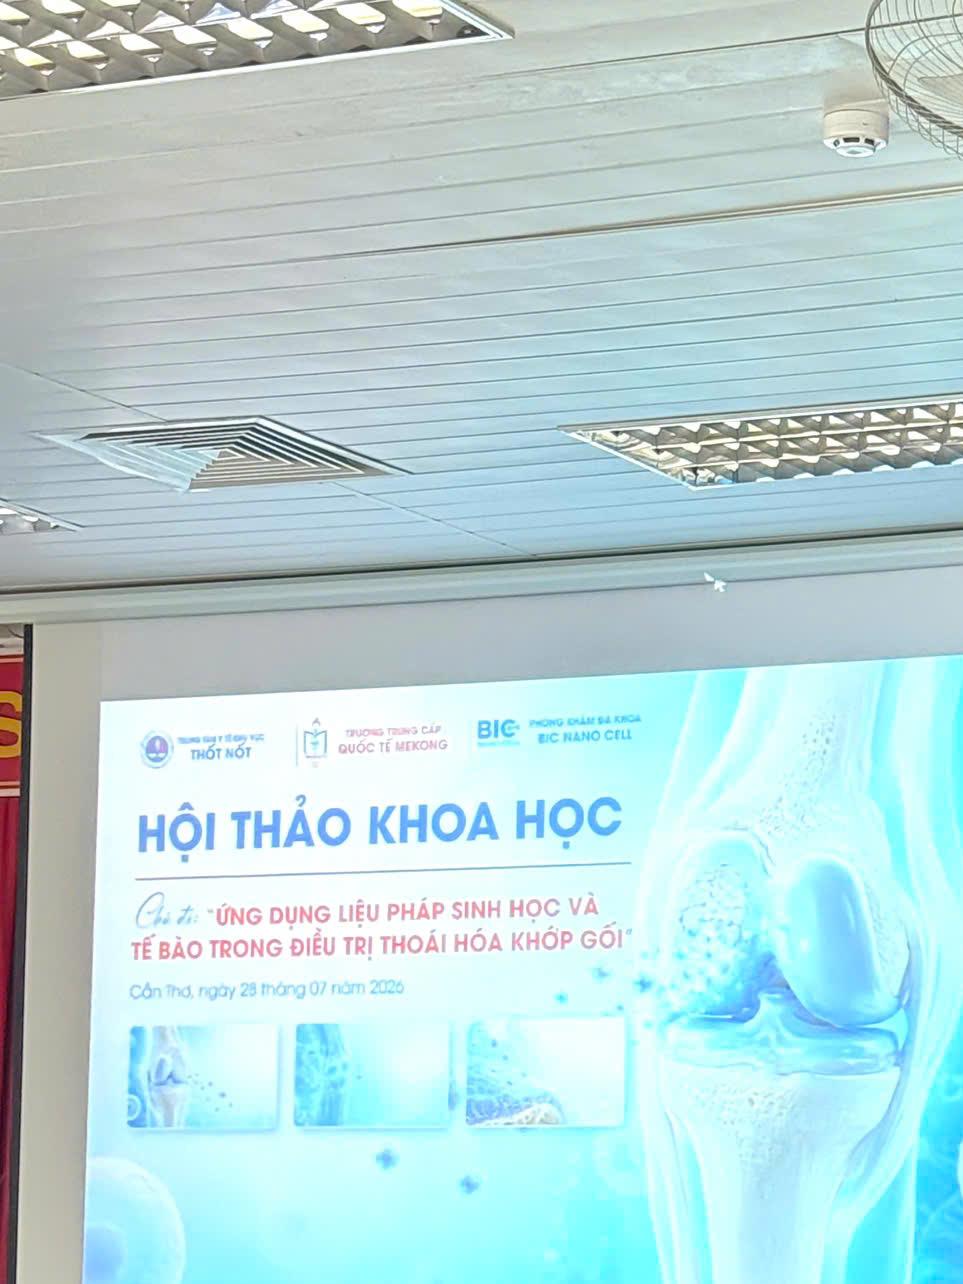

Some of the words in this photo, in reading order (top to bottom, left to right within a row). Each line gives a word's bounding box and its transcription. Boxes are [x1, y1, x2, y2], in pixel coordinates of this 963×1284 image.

[477, 719, 518, 740] BIC
[563, 730, 601, 743] NANO
[604, 729, 632, 742] CELL
[395, 739, 449, 753] MEKONG
[138, 801, 216, 863] HỘI
[230, 794, 352, 849] THẢO
[369, 801, 500, 845] KHOA
[516, 796, 622, 849] HỌC
[136, 891, 171, 928] Ch
[269, 905, 331, 930] DỤNG
[339, 898, 380, 928] LIỆU
[387, 897, 445, 921] PHÁP
[451, 900, 502, 920] SINH
[509, 898, 561, 923] HỌC
[568, 891, 599, 915] VÀ
[131, 933, 156, 960] TẾ
[159, 936, 204, 960] BÀO
[209, 938, 284, 959] TRONG
[289, 927, 336, 957] ĐIỀU
[343, 936, 374, 961] TRỊ
[380, 929, 447, 955] THOÁI
[454, 927, 503, 952] HÓA
[511, 925, 574, 951] KHỚP
[309, 980, 327, 996] 07
[370, 979, 405, 995] 2026
